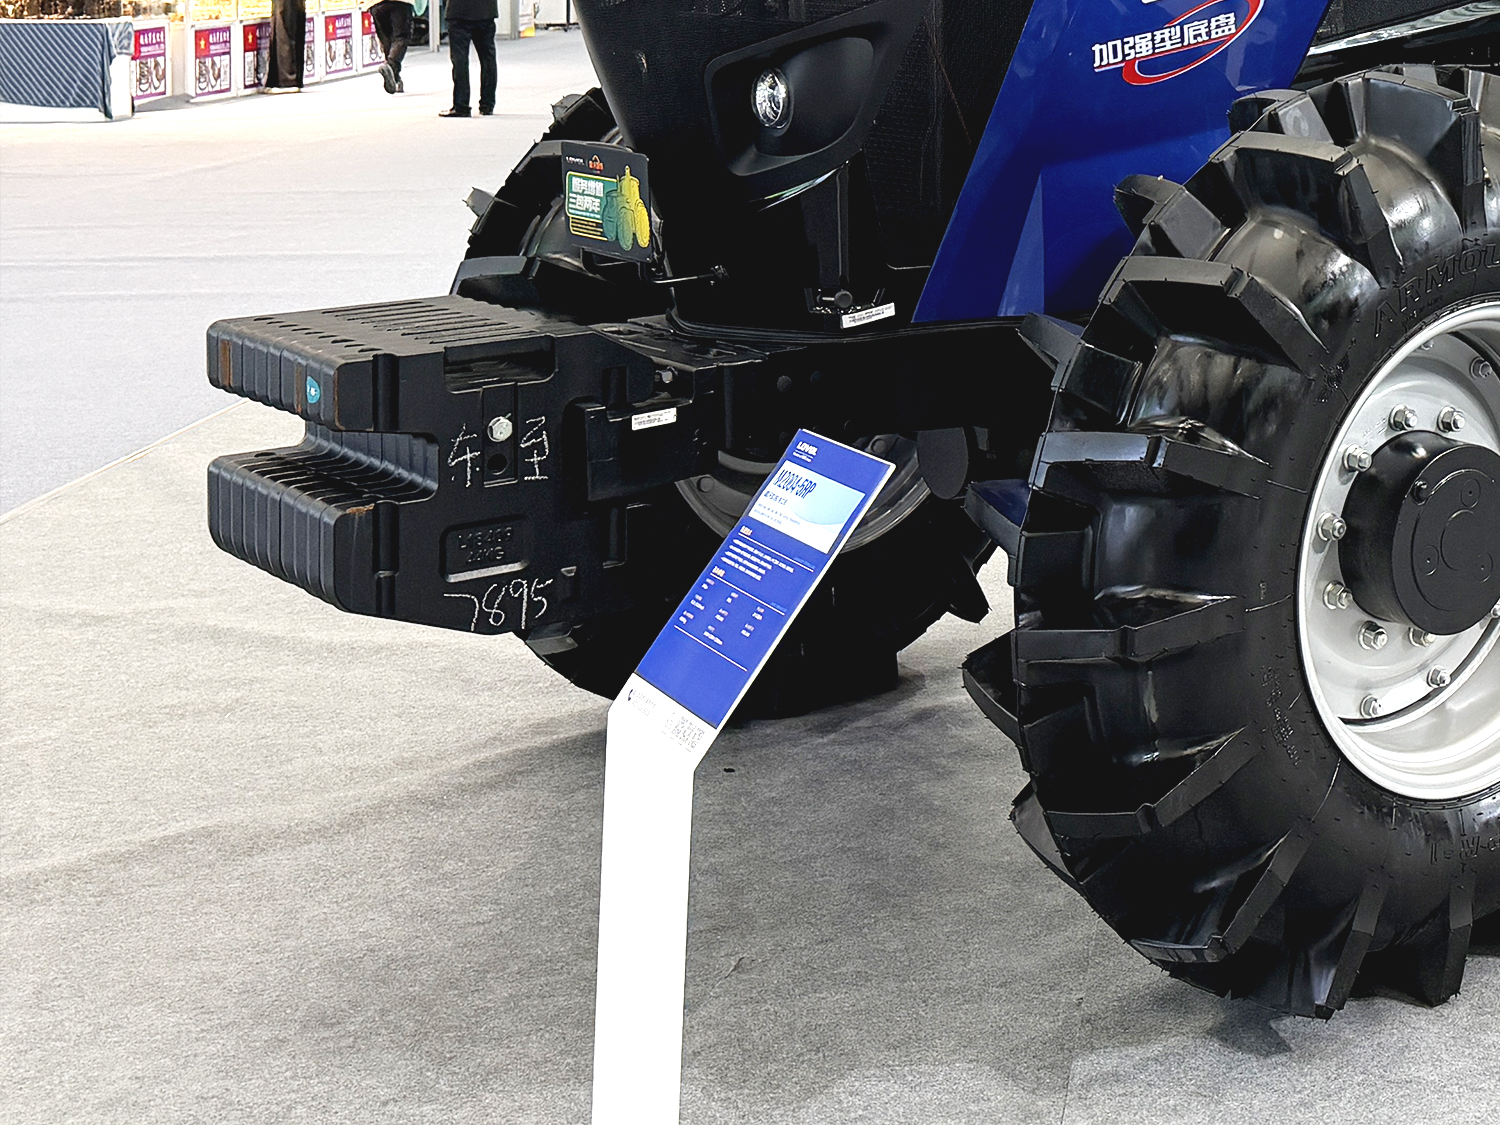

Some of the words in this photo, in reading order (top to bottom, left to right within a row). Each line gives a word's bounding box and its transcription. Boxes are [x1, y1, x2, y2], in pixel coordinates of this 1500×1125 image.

[1091, 12, 1237, 68] 加强型底盘
[443, 578, 554, 632] 7895
